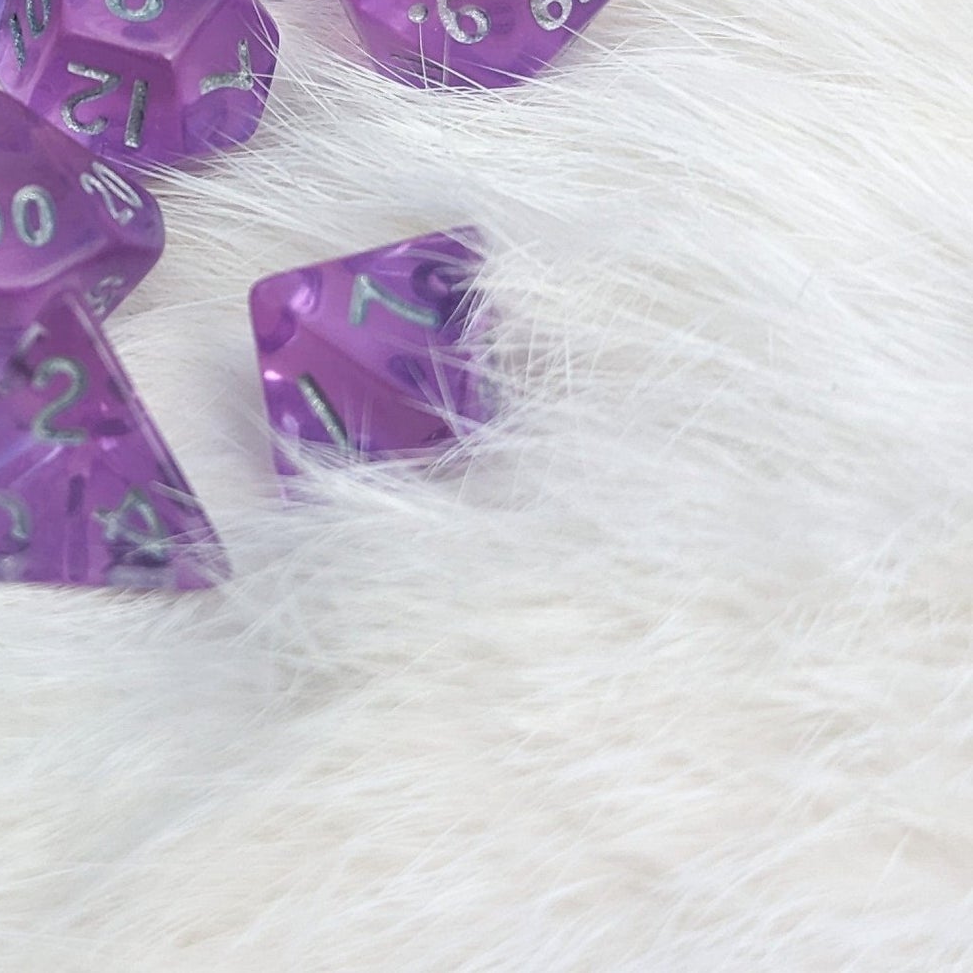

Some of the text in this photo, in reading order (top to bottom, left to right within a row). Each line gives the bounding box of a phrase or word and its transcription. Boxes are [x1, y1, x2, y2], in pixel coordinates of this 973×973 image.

[60, 61, 149, 148] 12
[80, 161, 143, 225] 20
[31, 356, 87, 445] 2
